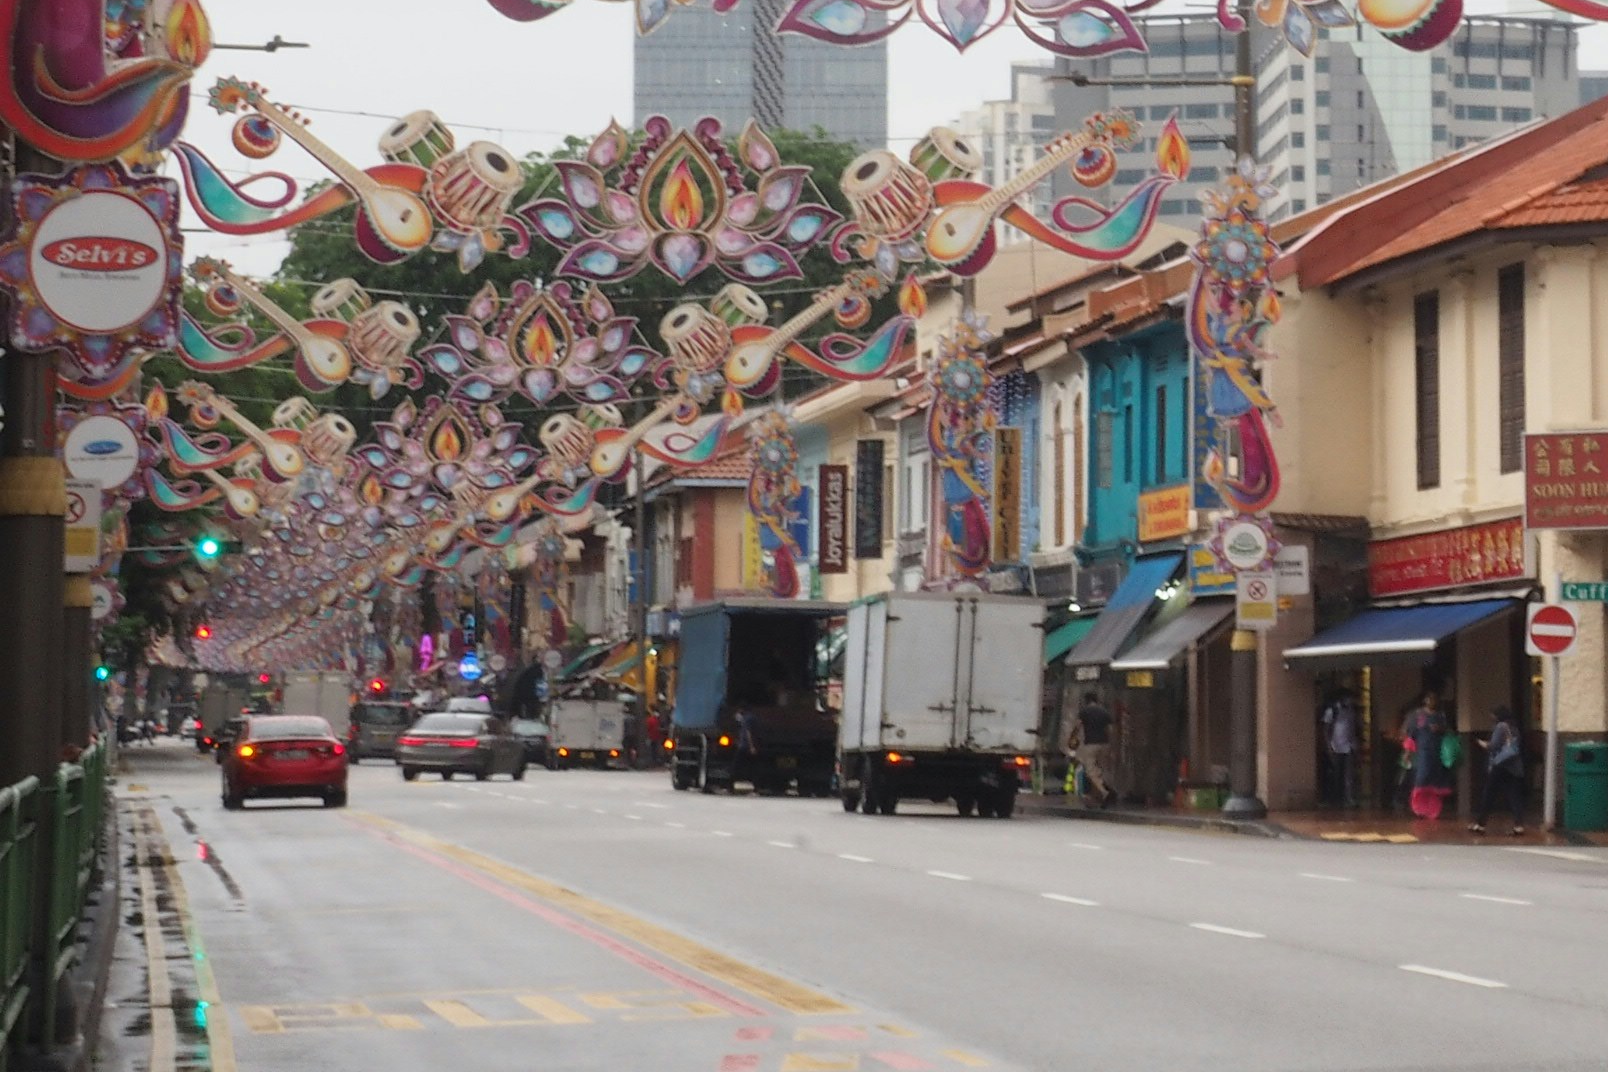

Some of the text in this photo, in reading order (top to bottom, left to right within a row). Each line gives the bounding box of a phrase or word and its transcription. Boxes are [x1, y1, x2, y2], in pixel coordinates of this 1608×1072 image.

[56, 243, 147, 266] Selvi's
[1533, 483, 1575, 499] SOON
[1565, 583, 1608, 600] Cuff
